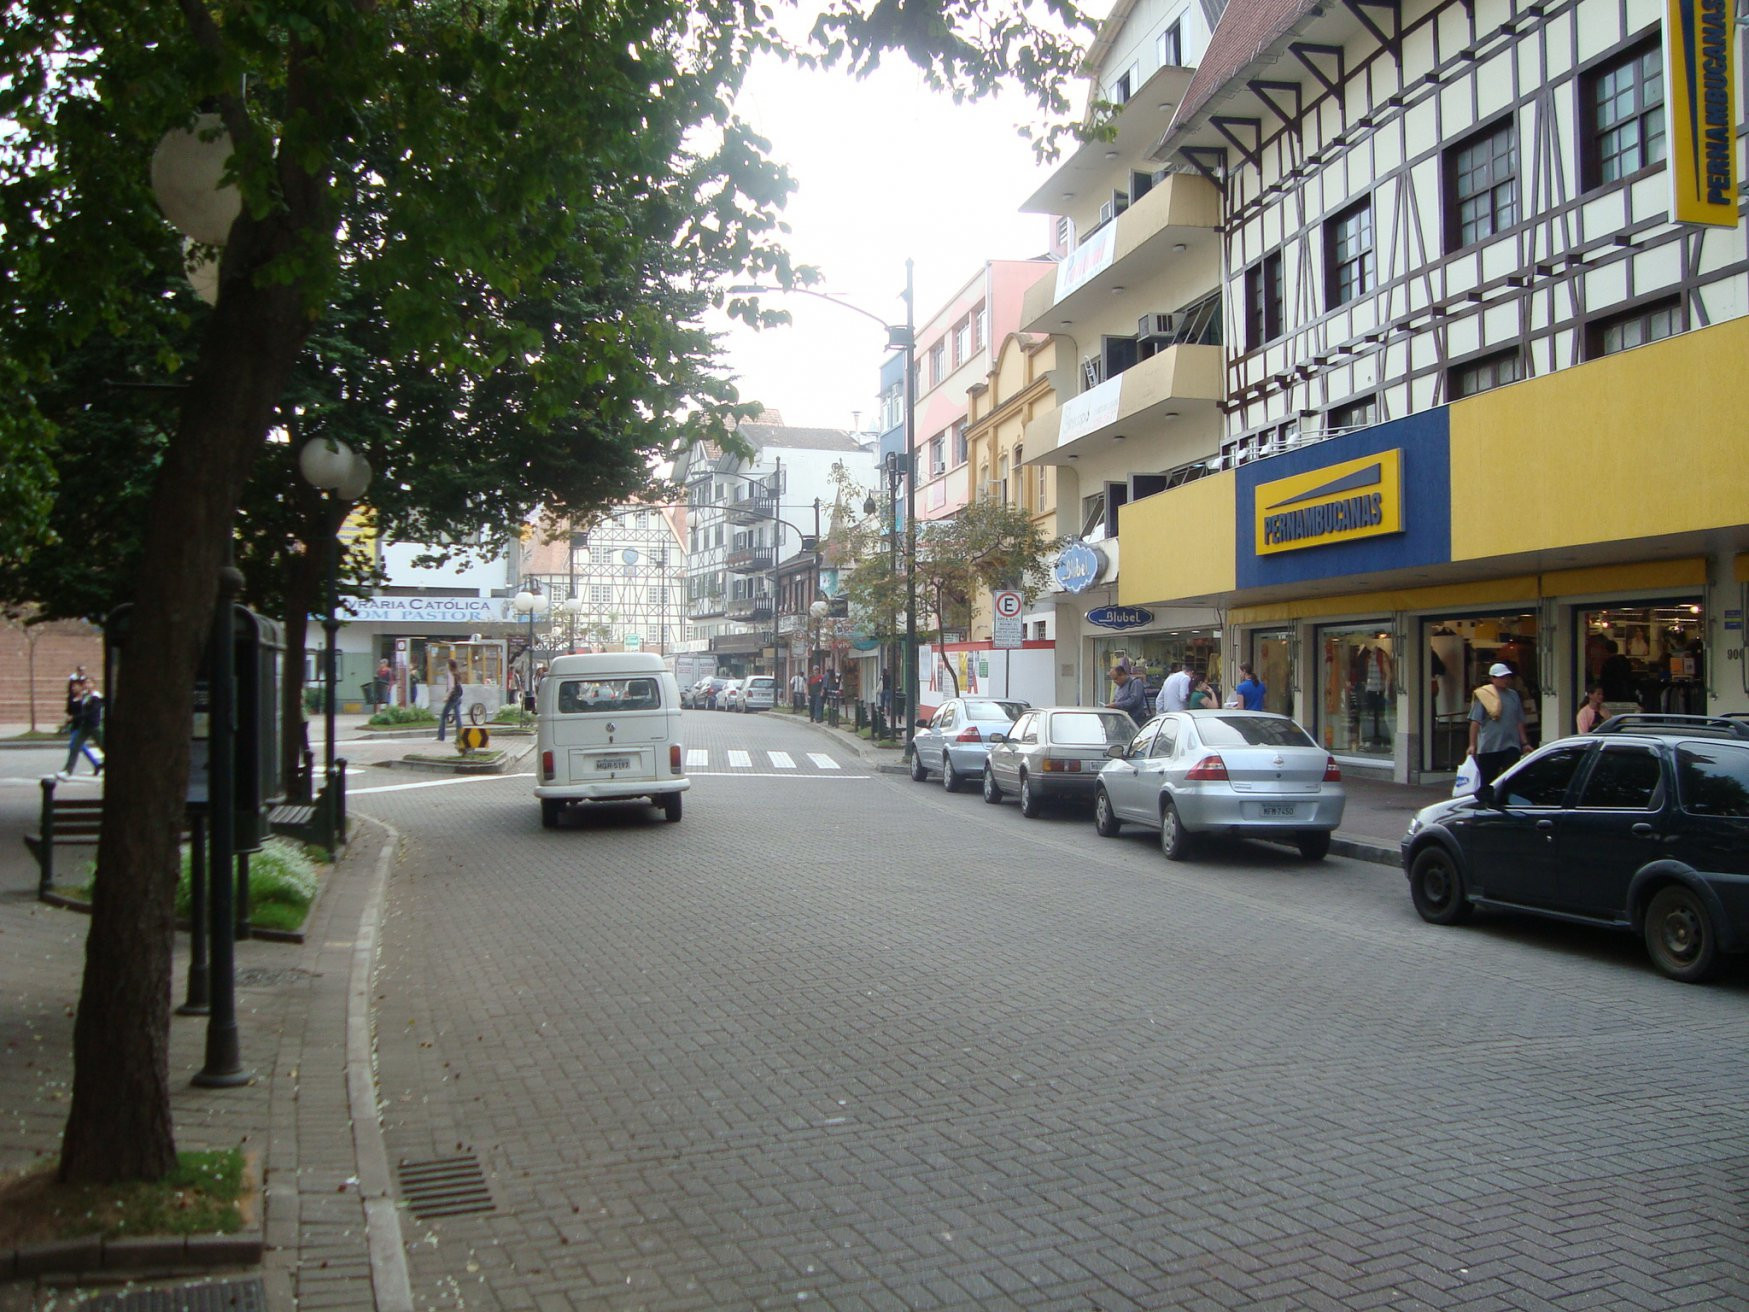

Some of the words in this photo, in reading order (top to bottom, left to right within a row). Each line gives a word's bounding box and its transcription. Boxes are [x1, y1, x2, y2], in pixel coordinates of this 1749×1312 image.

[1701, 0, 1731, 205] PERNAMBUCANAS
[1263, 492, 1383, 546] PERNAMBUCANAS
[345, 599, 407, 610] VRARIA
[1004, 597, 1014, 612] E
[402, 610, 482, 621] PASTOR
[1098, 611, 1141, 623] Blubel
